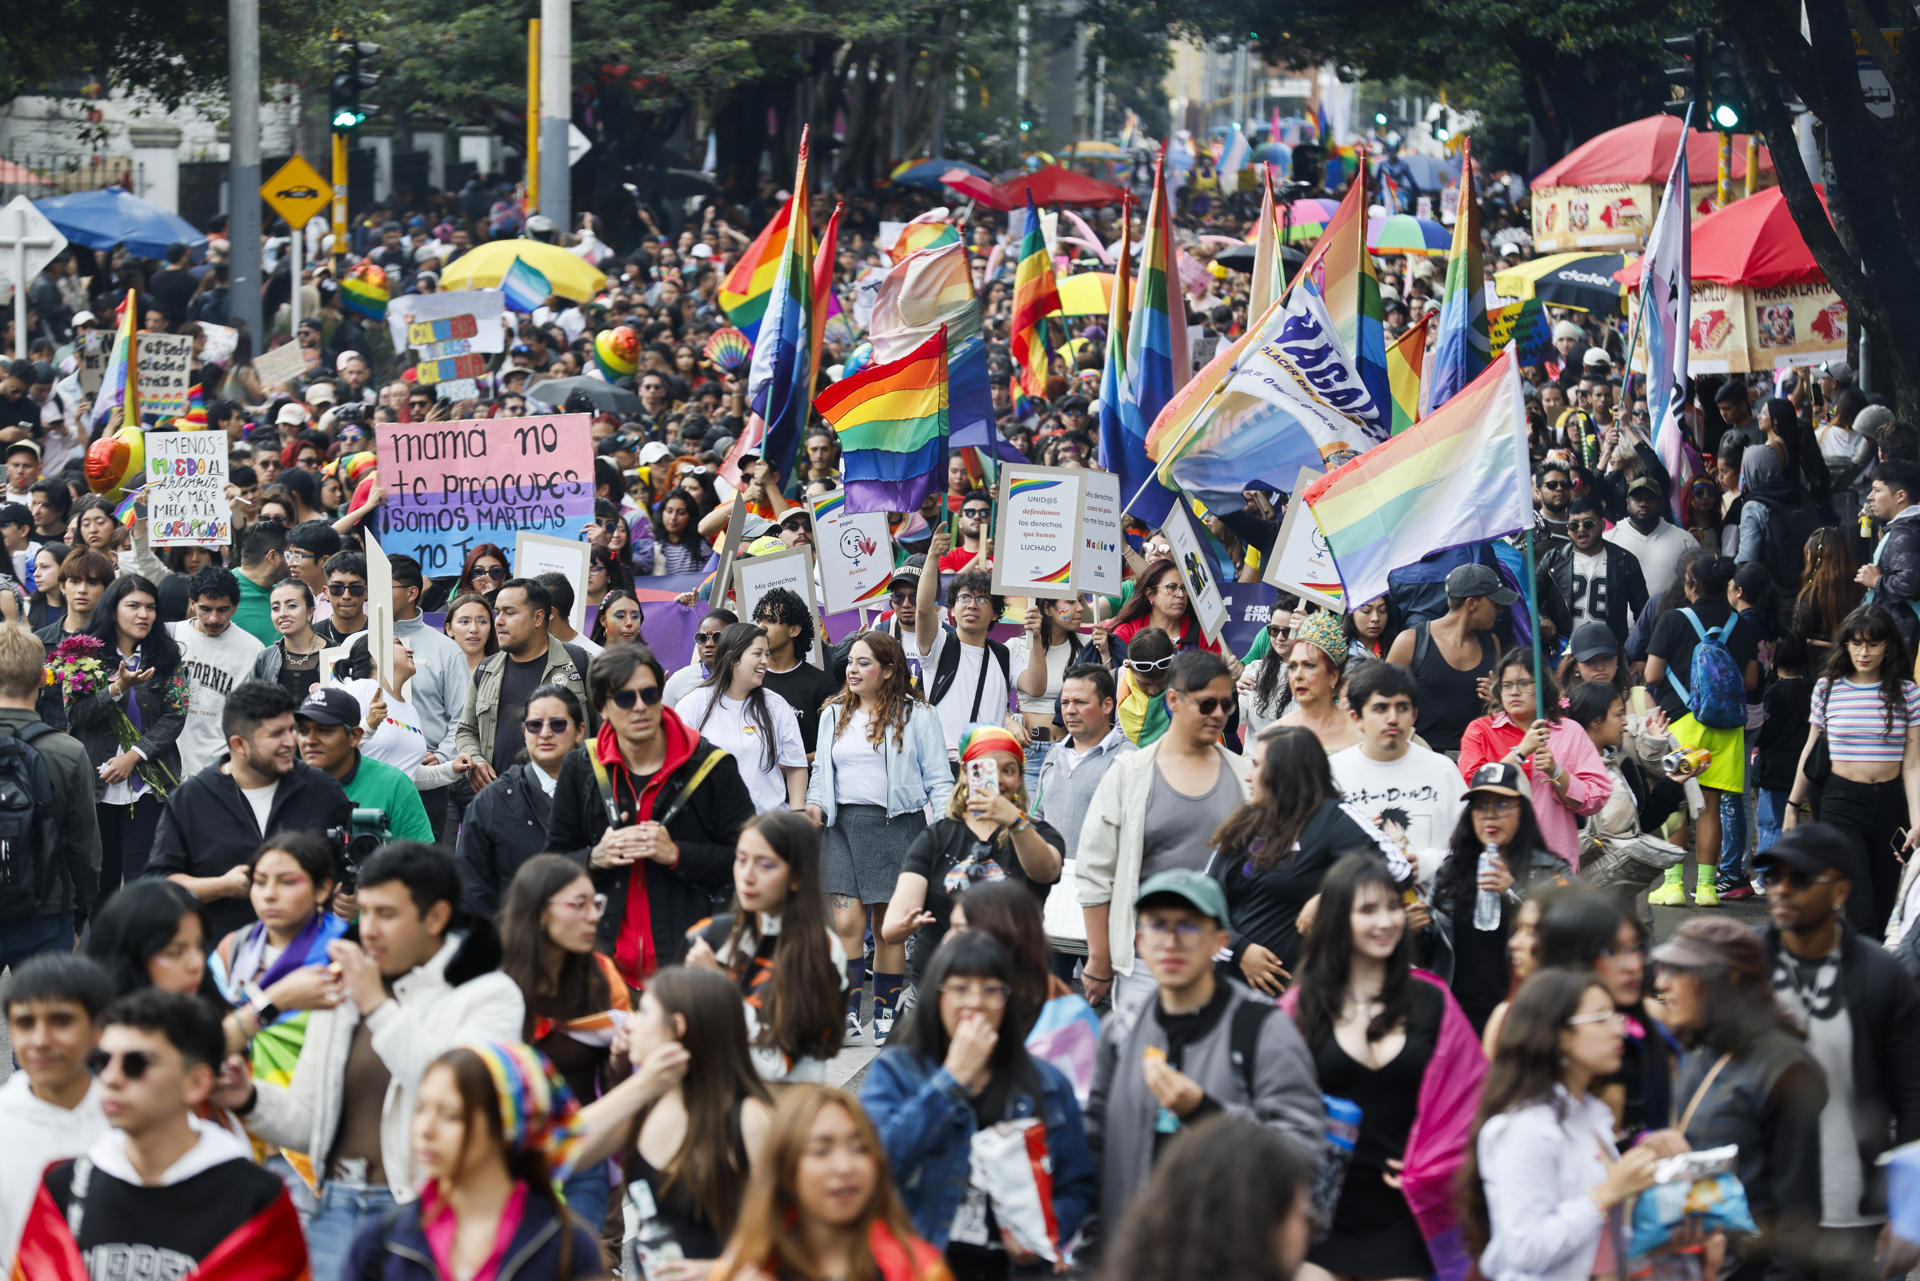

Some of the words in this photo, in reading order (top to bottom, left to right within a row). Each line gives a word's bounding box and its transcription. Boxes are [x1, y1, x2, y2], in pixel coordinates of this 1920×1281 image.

[138, 357, 186, 372] ciedad
[165, 436, 216, 455] MENOS
[391, 423, 487, 463] mamá
[514, 423, 558, 456] no
[208, 459, 224, 476] AL
[171, 490, 184, 503] Y
[391, 470, 427, 507] te
[1027, 496, 1058, 504] UNID@S
[154, 503, 187, 519] MIEDO
[192, 503, 199, 515] A
[203, 502, 217, 516] LA
[477, 504, 566, 532] MARICAS
[1030, 520, 1062, 528] derechos
[1020, 544, 1057, 552] LUCHADO
[413, 544, 447, 569] no
[754, 583, 767, 591] Mis
[767, 576, 797, 588] derechos
[1245, 605, 1270, 614] #SIN
